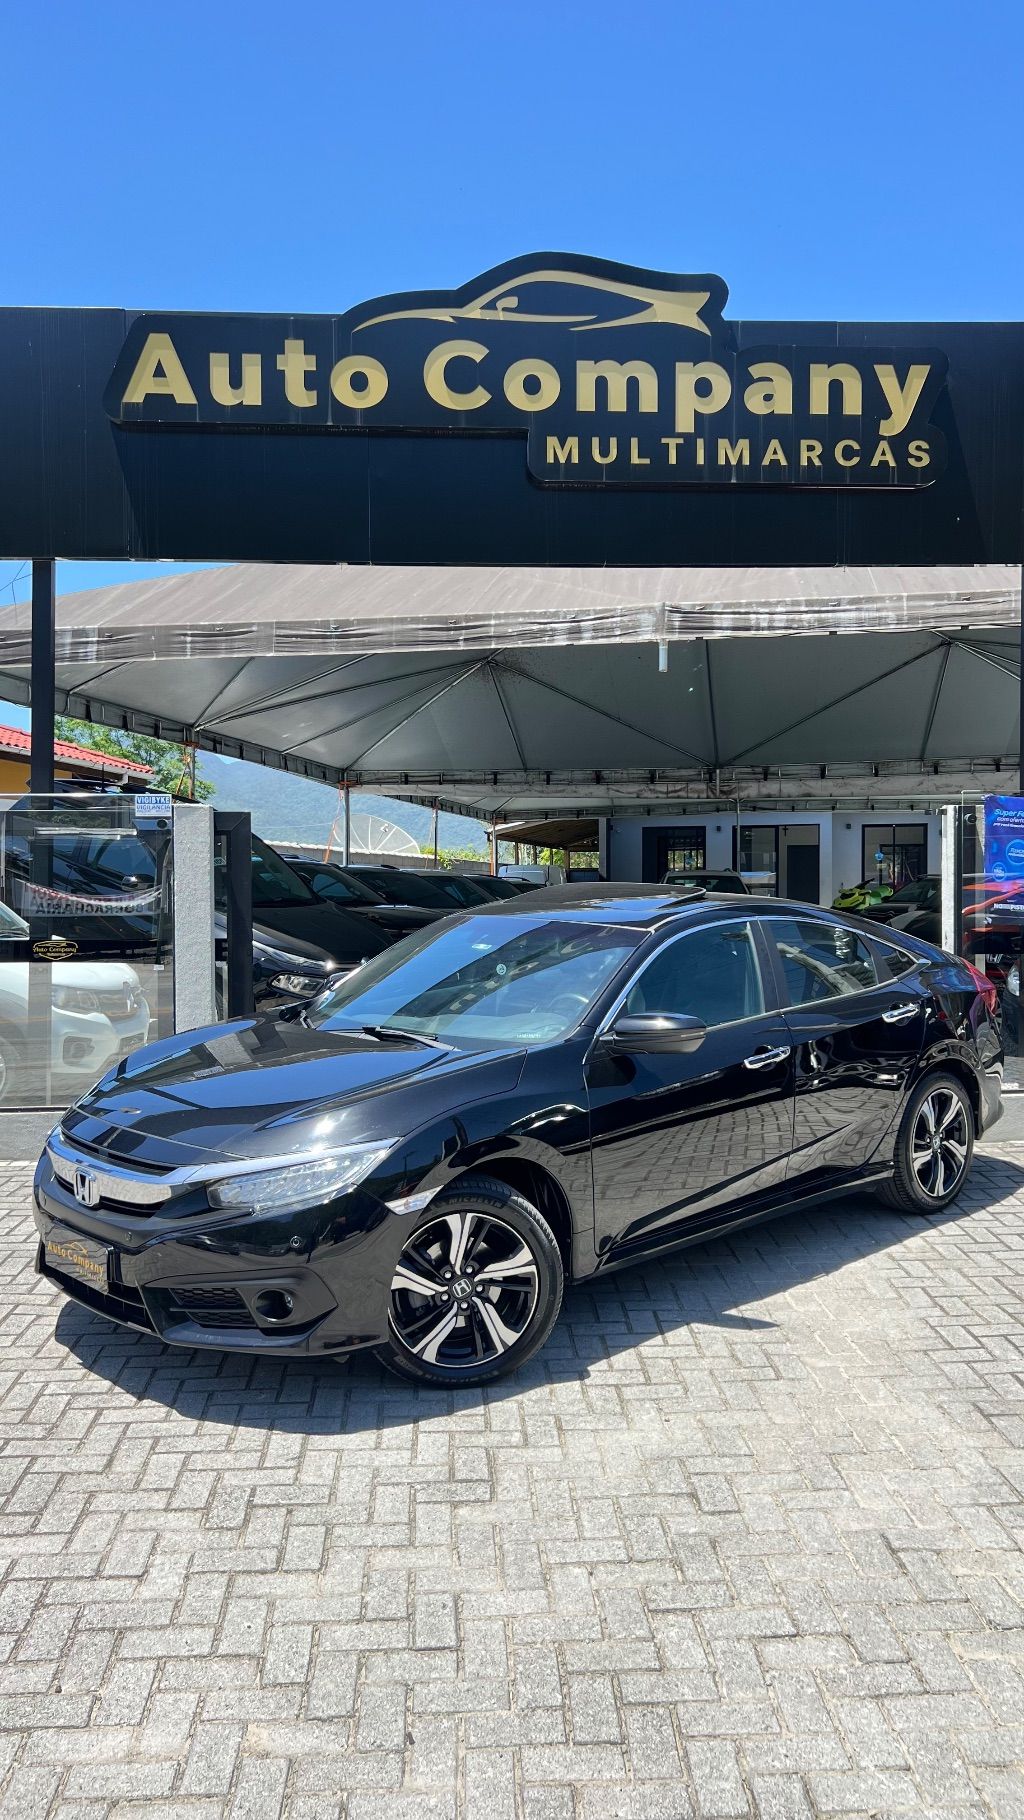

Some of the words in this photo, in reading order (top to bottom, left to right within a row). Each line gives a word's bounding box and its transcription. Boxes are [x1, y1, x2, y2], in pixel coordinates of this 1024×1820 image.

[121, 332, 389, 409] Auto
[423, 339, 931, 436] Company
[545, 435, 931, 468] MULTIMARCAS
[137, 796, 170, 804] VIGIBYKE
[994, 808, 1018, 817] Super
[48, 1241, 65, 1257] Auto
[67, 1250, 104, 1278] Company
